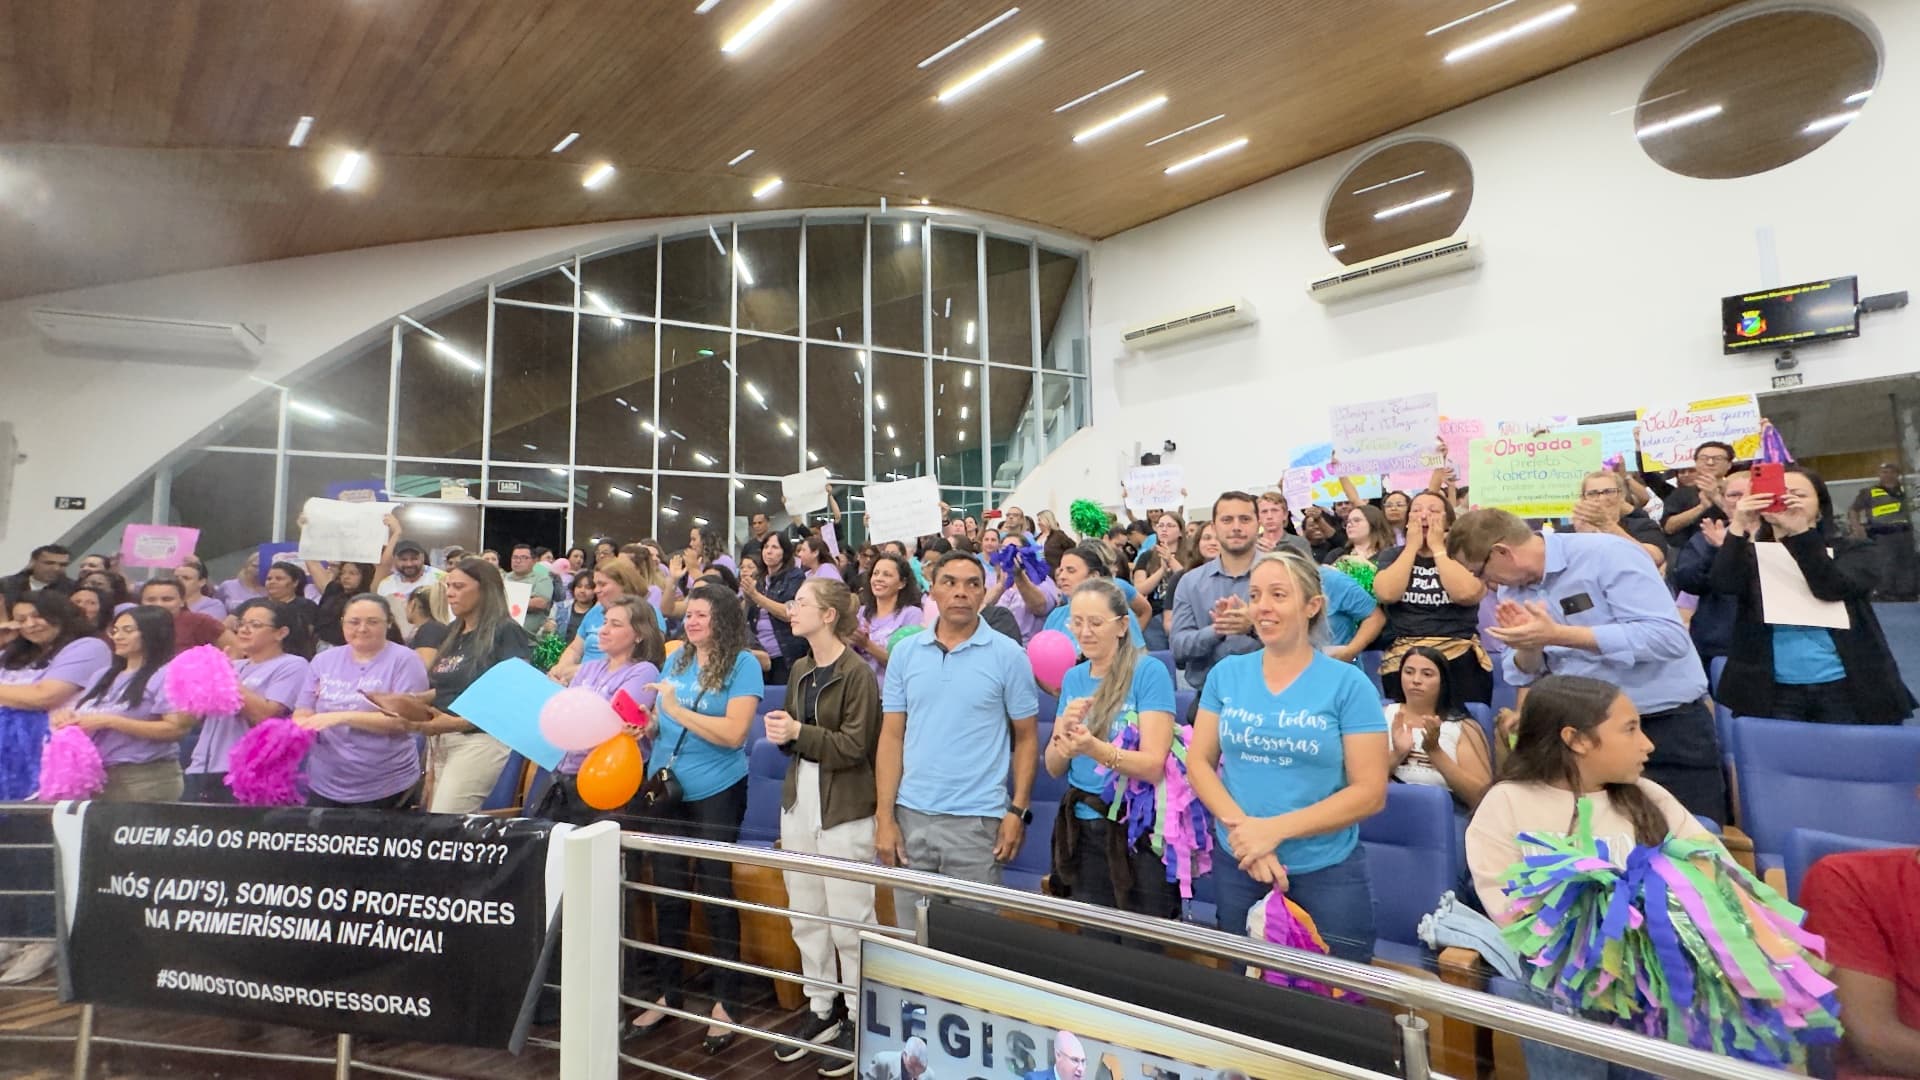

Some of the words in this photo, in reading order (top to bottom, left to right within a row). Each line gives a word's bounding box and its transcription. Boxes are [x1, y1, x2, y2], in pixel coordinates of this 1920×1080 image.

[1494, 438, 1572, 458] Obrigada
[1402, 591, 1453, 606] DUCAÇÃ
[1270, 709, 1327, 730] todas
[1220, 719, 1320, 756] Professoras
[1278, 756, 1293, 765] SP
[114, 826, 171, 846] QUEM
[172, 825, 213, 847] SÃO
[217, 830, 243, 848] OS
[247, 831, 379, 856] PROFESSORES
[383, 837, 423, 859] NOS
[235, 882, 313, 908] SOMOS
[317, 887, 348, 911] OS
[352, 890, 516, 925] PROFESSORES
[145, 907, 170, 931] NA
[174, 908, 332, 943] PRIMEIRÍSSIMA
[337, 919, 444, 954] INFÂNCIA!
[156, 968, 432, 1017] #SOMOSTODASPROFESSORAS
